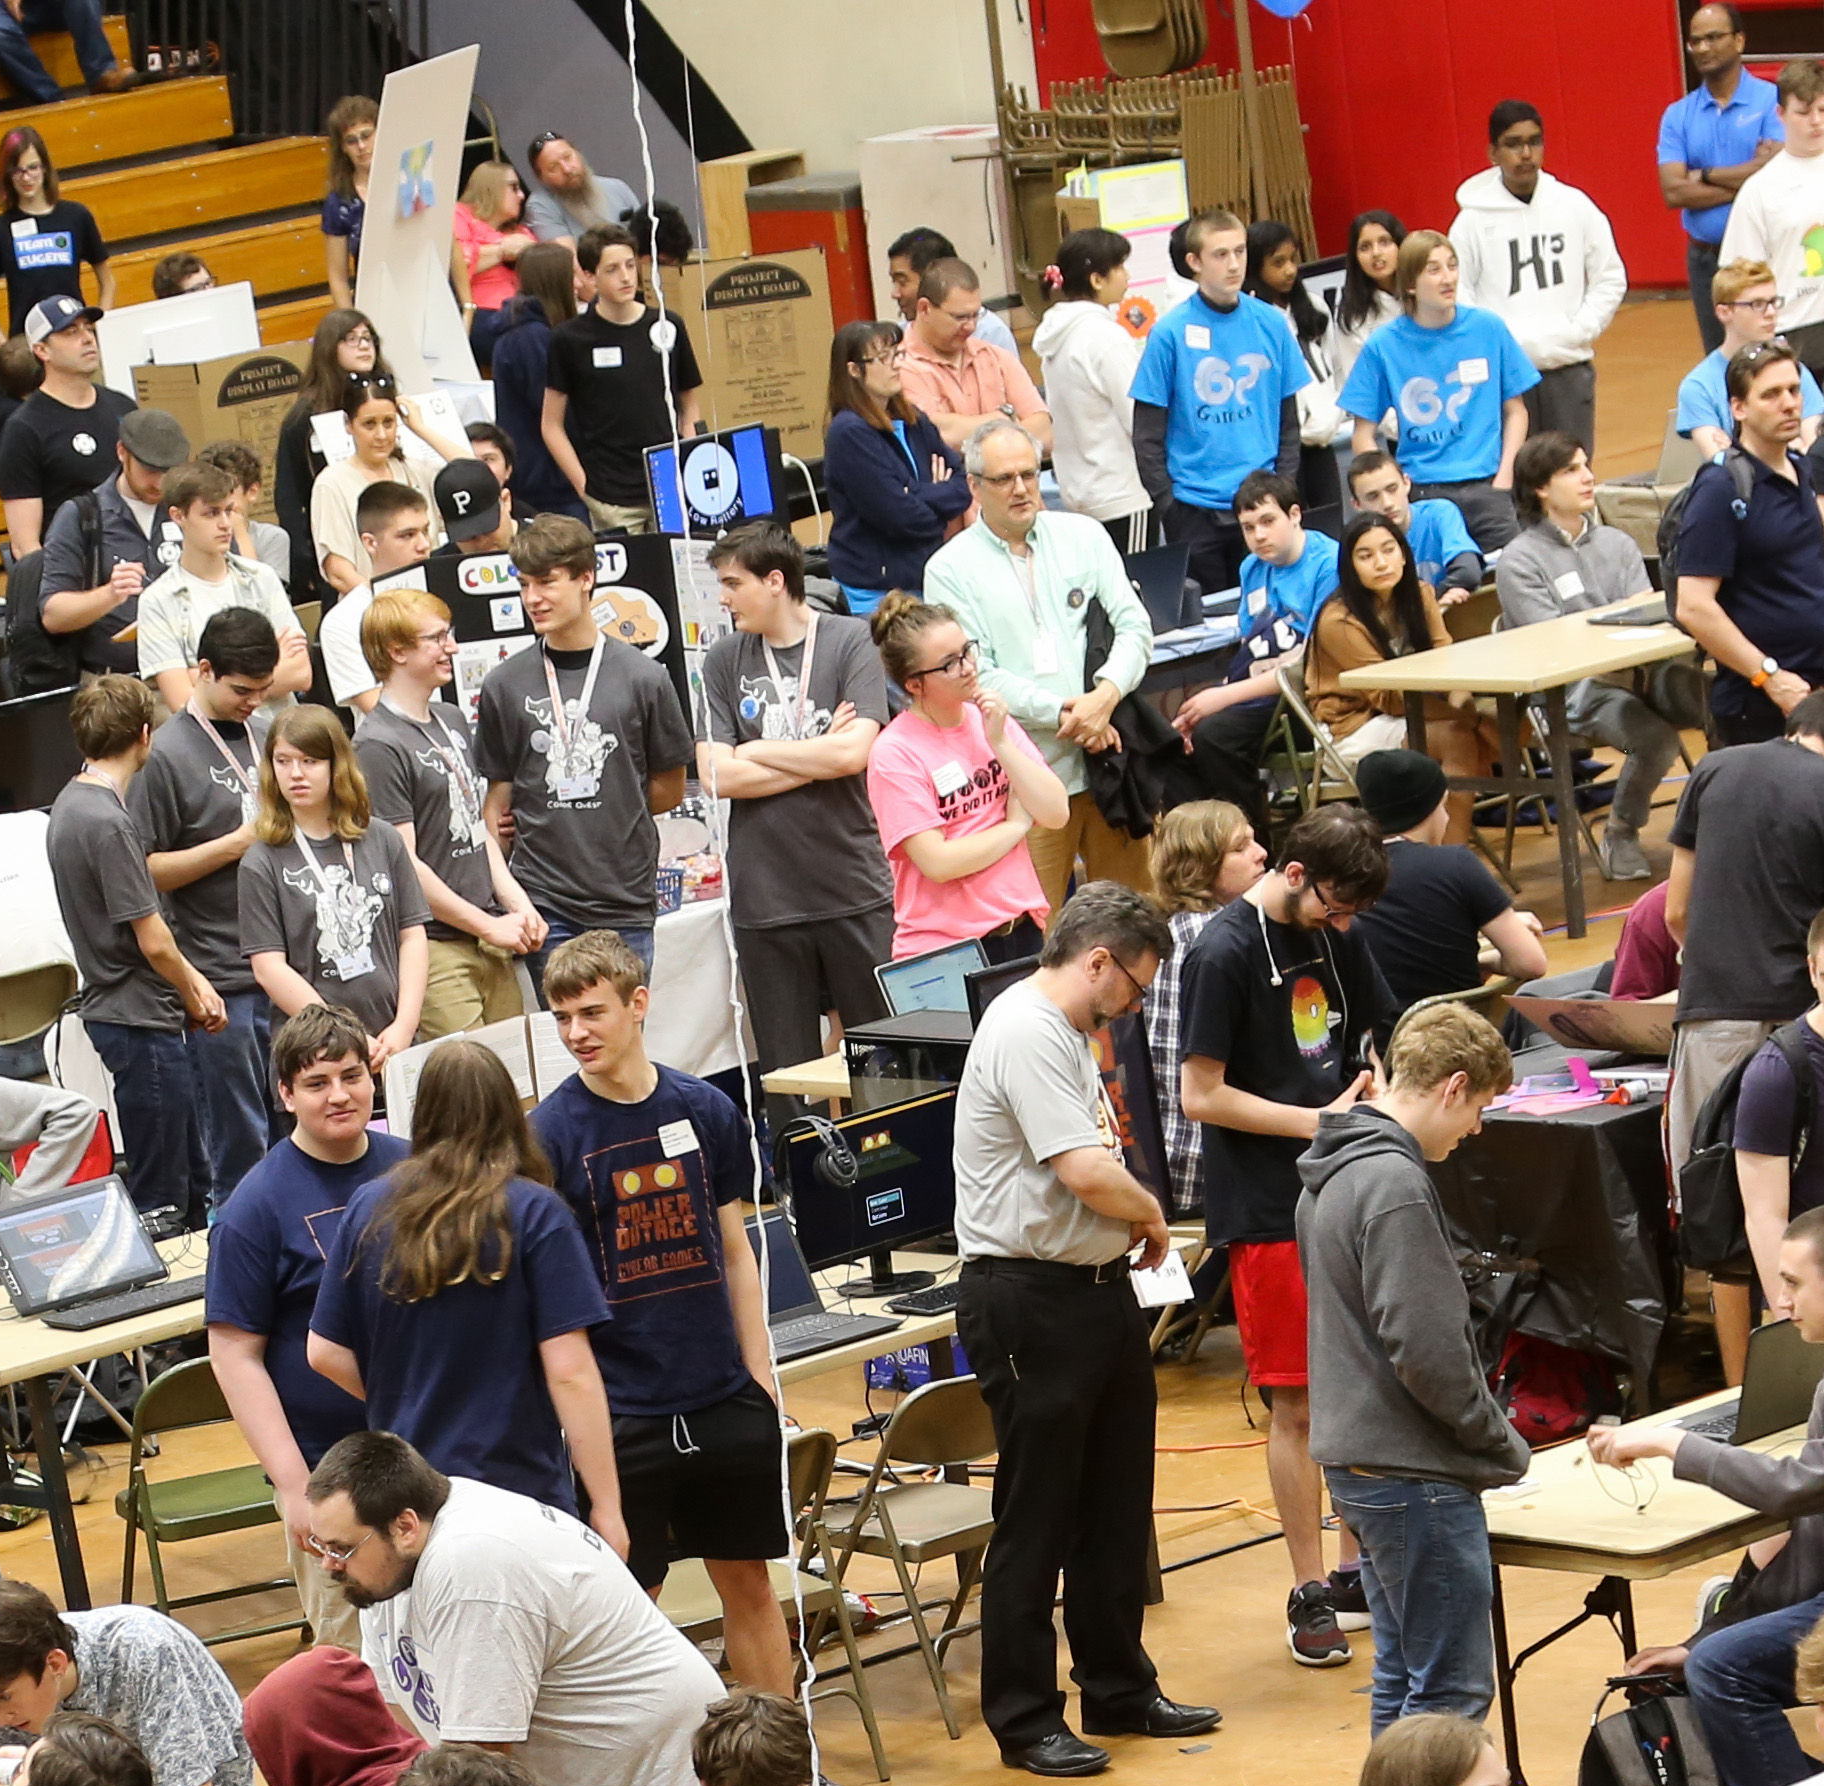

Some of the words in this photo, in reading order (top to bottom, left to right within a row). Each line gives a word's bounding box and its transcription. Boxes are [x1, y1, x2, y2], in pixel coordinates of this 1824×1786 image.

[714, 282, 760, 301] DISPLAY
[763, 279, 801, 296] BOARD
[730, 269, 781, 285] PROJECT
[617, 1194, 691, 1228] POWER
[616, 1214, 698, 1250] OUTAGE
